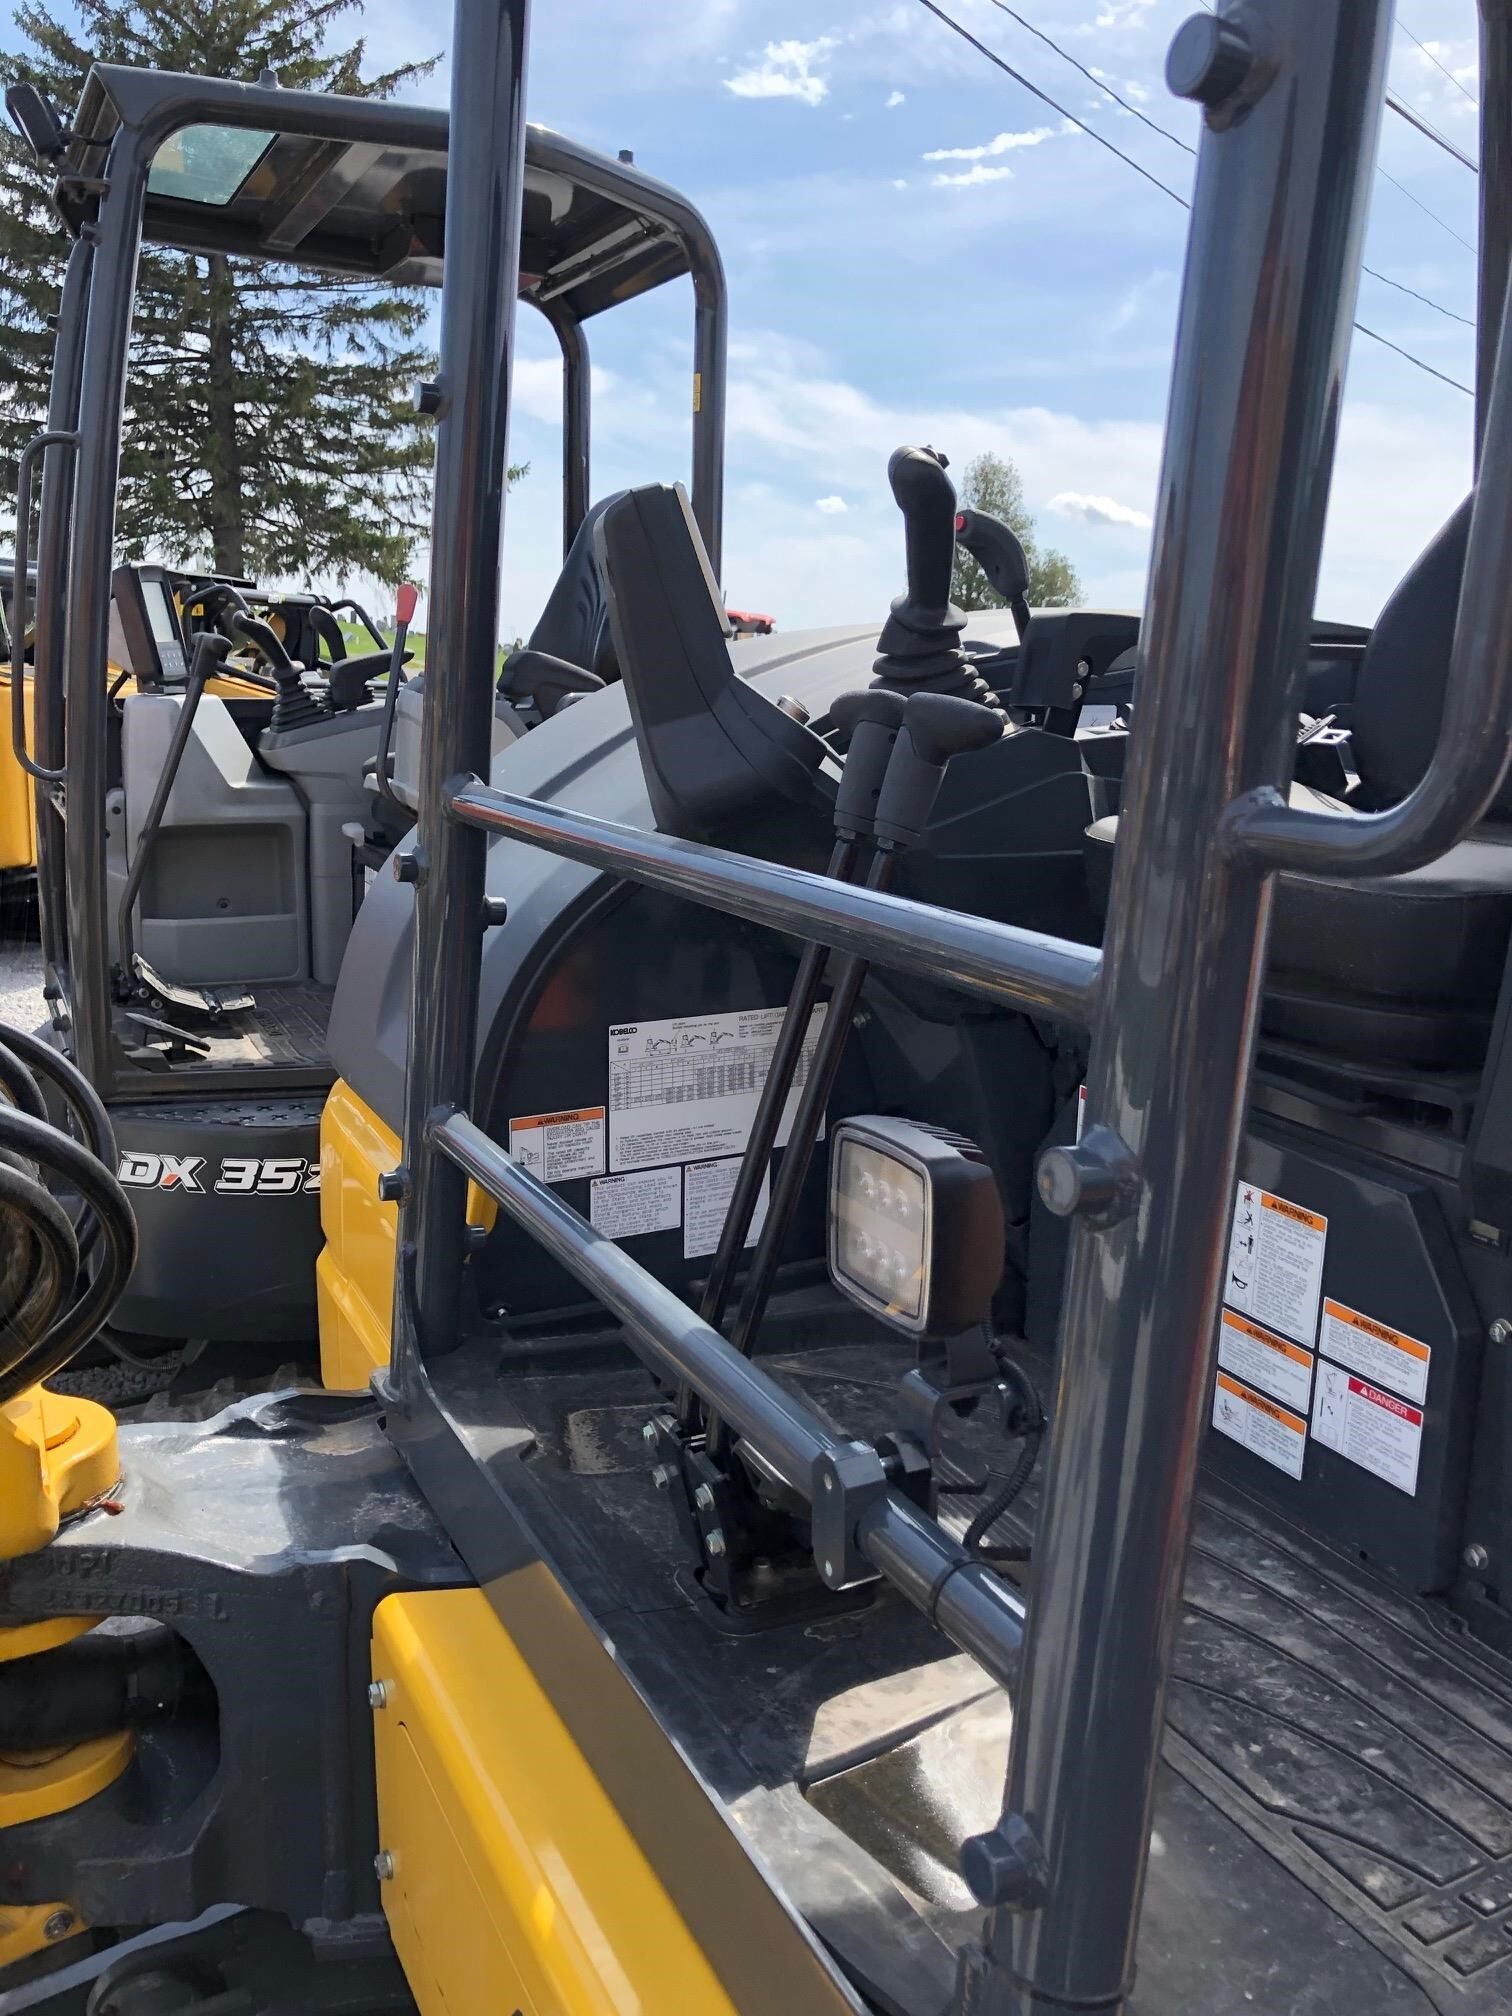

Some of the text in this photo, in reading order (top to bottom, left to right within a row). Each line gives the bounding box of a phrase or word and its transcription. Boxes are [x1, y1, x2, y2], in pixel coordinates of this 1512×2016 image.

[610, 1027, 638, 1036] KOBELCO
[544, 1113, 579, 1124] WARNING
[118, 1151, 207, 1194] DX
[1277, 1201, 1314, 1225] WARNING
[1253, 1329, 1287, 1353] WARNING
[1359, 1319, 1399, 1345] WARNING
[1247, 1394, 1281, 1419] WARNING
[1369, 1389, 1408, 1417] DANGER
